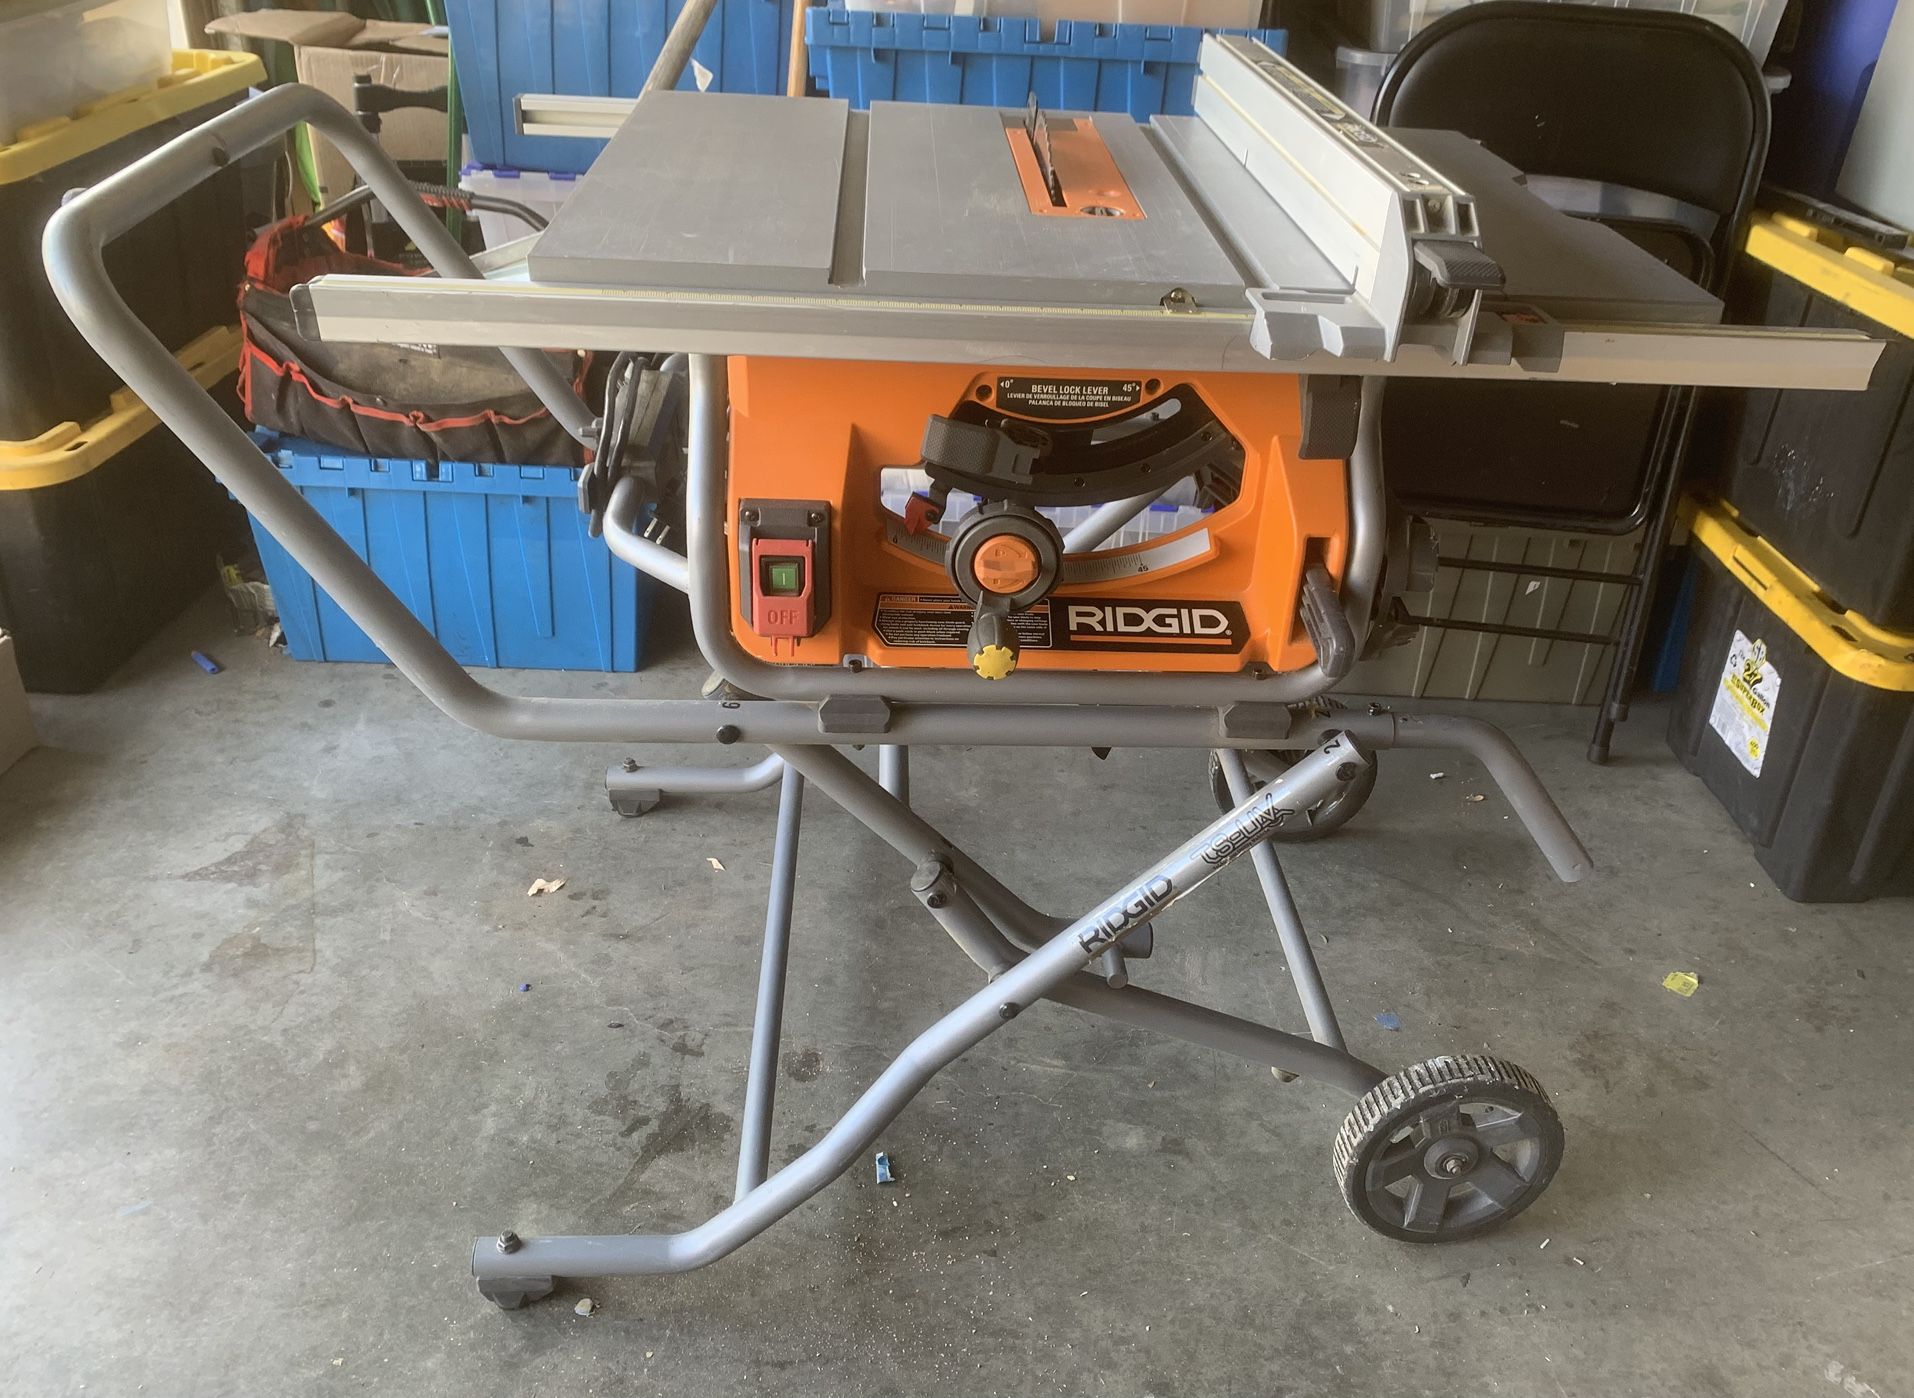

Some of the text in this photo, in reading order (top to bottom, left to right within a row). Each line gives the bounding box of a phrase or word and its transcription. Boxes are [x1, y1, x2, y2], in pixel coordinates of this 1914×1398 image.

[1031, 384, 1109, 395] BEVEL LOCK LEVER
[1122, 382, 1136, 392] 45°
[767, 609, 798, 624] OFF
[1068, 605, 1229, 635] RIDGID
[1323, 738, 1340, 754] 2
[1078, 874, 1172, 954] RIDGID
